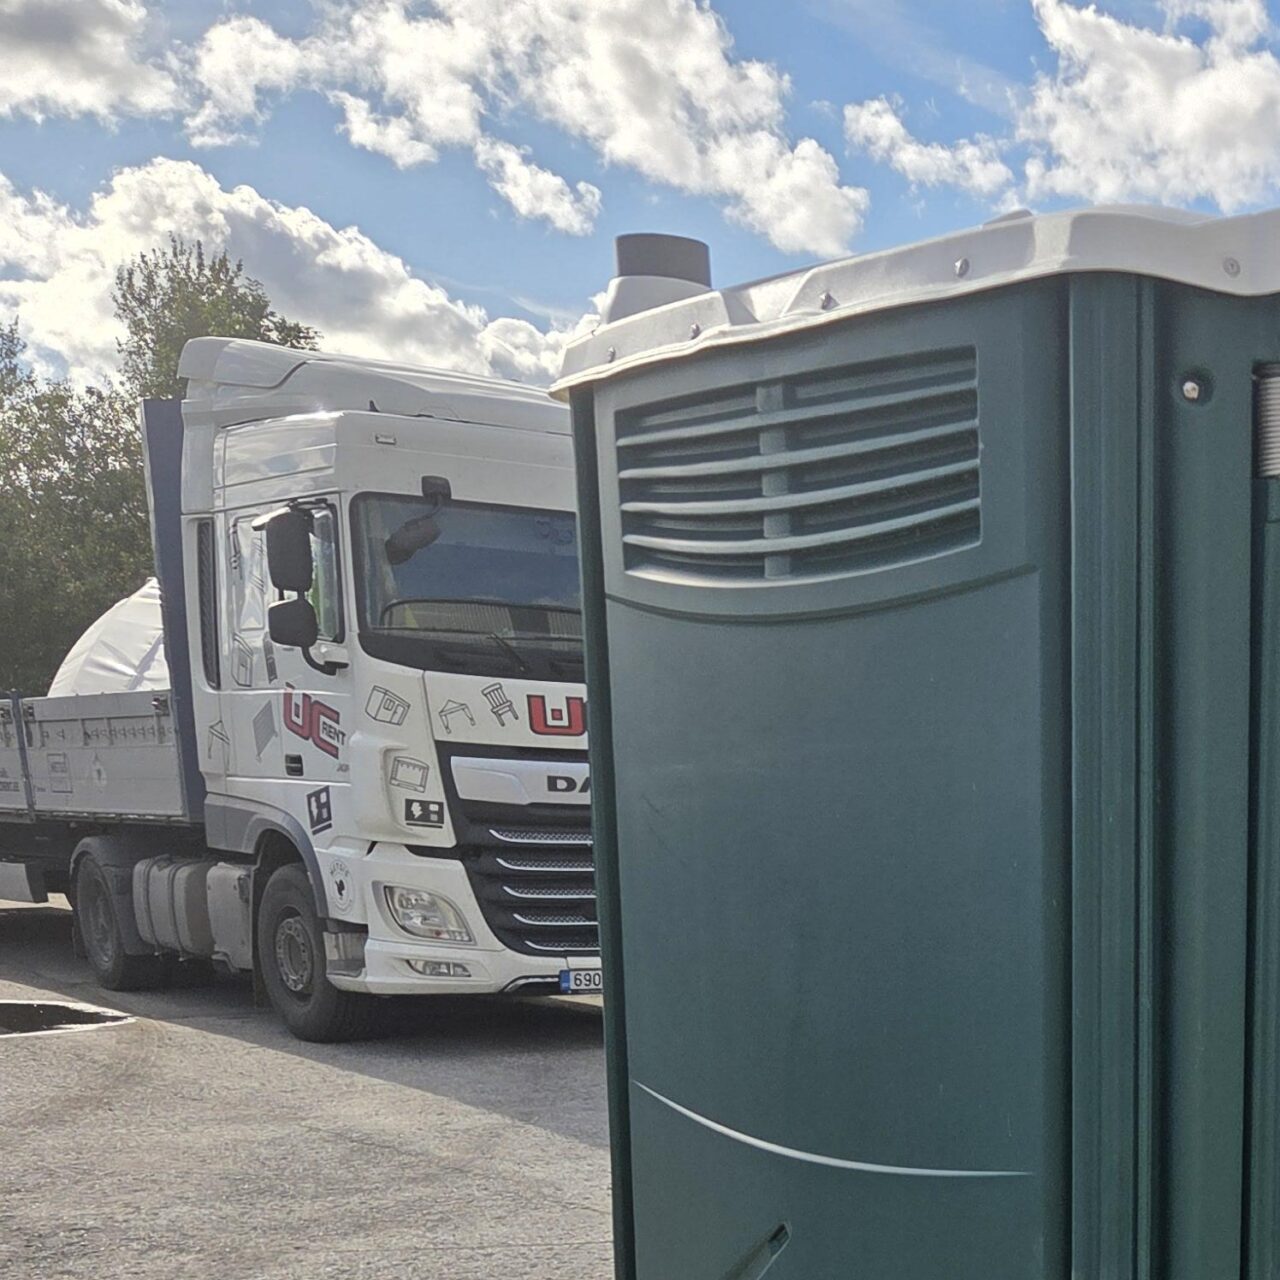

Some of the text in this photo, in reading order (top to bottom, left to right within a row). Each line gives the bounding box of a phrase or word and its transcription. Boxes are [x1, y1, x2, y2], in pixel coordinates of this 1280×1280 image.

[526, 694, 588, 736] U
[321, 720, 346, 746] RENT
[574, 972, 601, 987] 690
